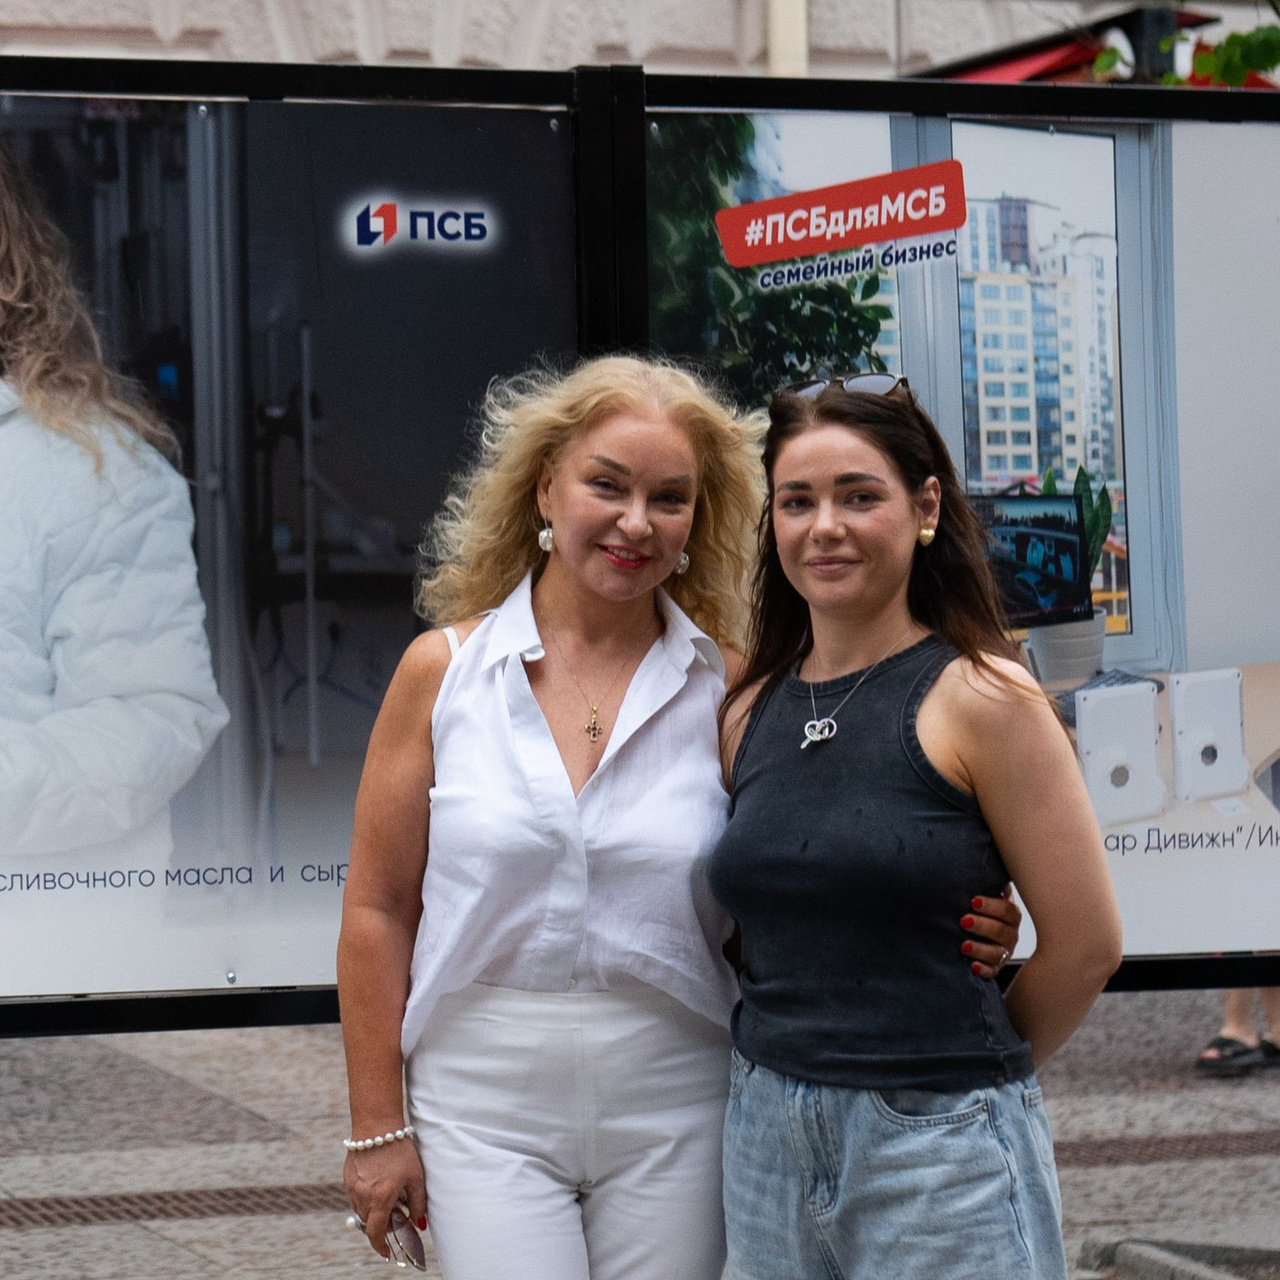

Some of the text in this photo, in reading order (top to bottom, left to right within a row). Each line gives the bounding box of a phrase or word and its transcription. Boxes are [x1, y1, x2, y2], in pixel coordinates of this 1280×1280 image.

[409, 210, 488, 241] ПСБ
[744, 185, 947, 247] #ПСБдляМСБ
[759, 239, 958, 289] семейный бизнес
[1104, 833, 1137, 856] ар
[165, 865, 253, 886] масла
[269, 865, 285, 883] и
[300, 863, 349, 887] сыр
